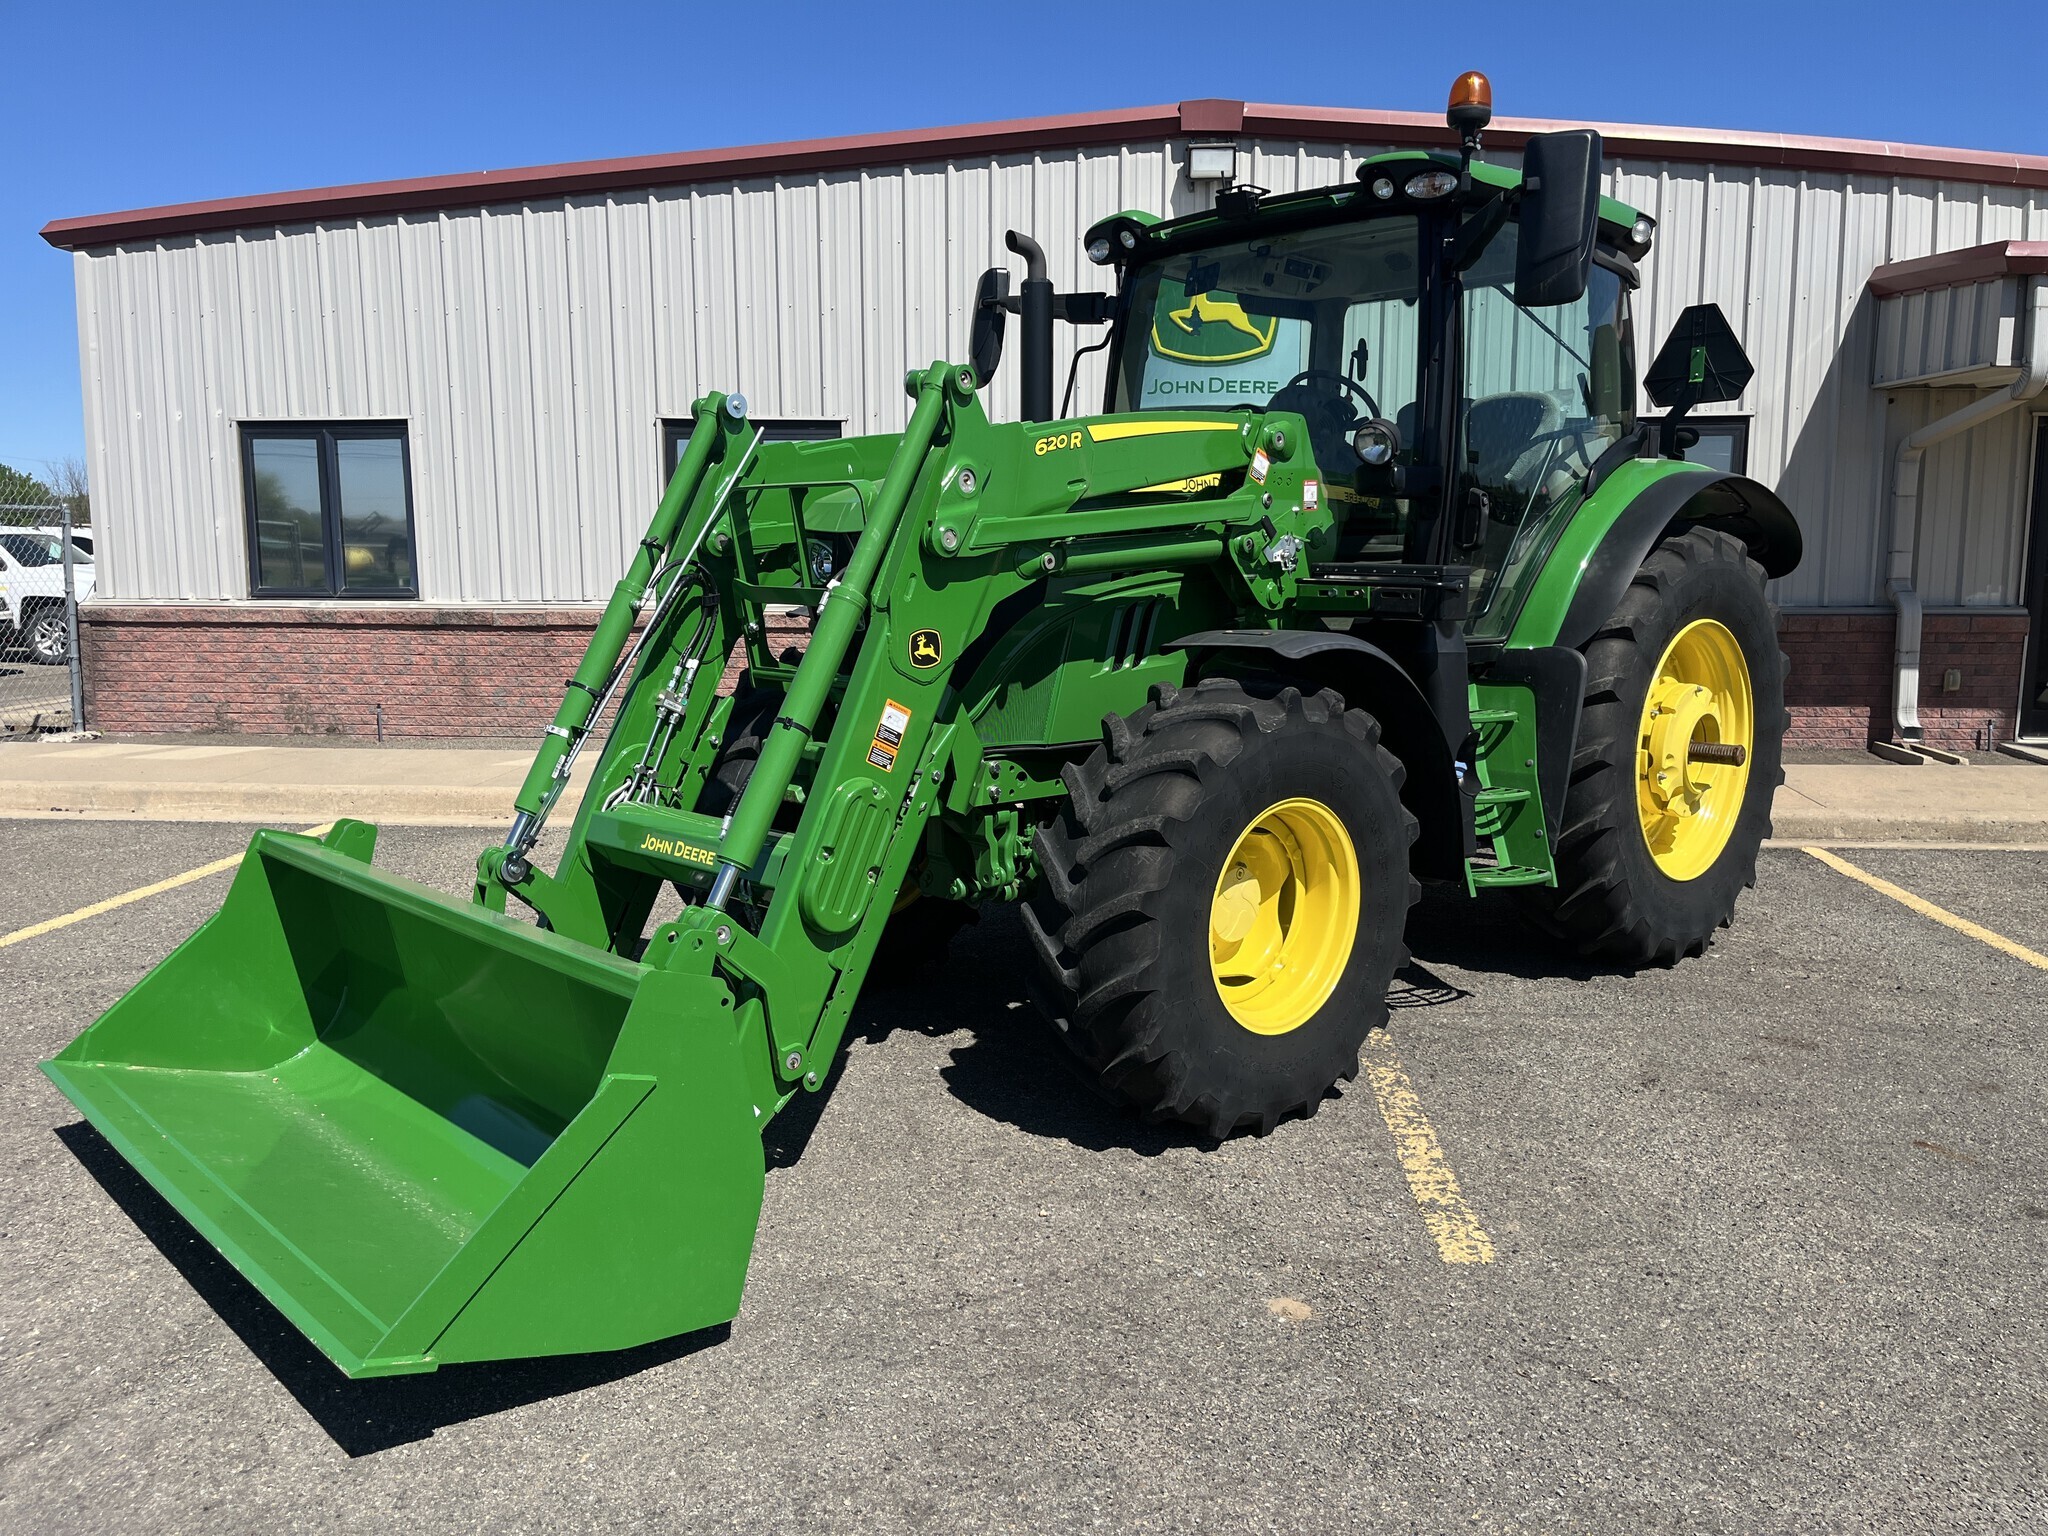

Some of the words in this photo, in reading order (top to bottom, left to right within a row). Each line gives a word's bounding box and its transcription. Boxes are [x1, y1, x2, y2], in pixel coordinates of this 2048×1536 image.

[1147, 378, 1204, 395] JOHN
[1208, 377, 1279, 394] DEERE
[640, 833, 673, 855] JOHN
[674, 840, 717, 866] DEERE
